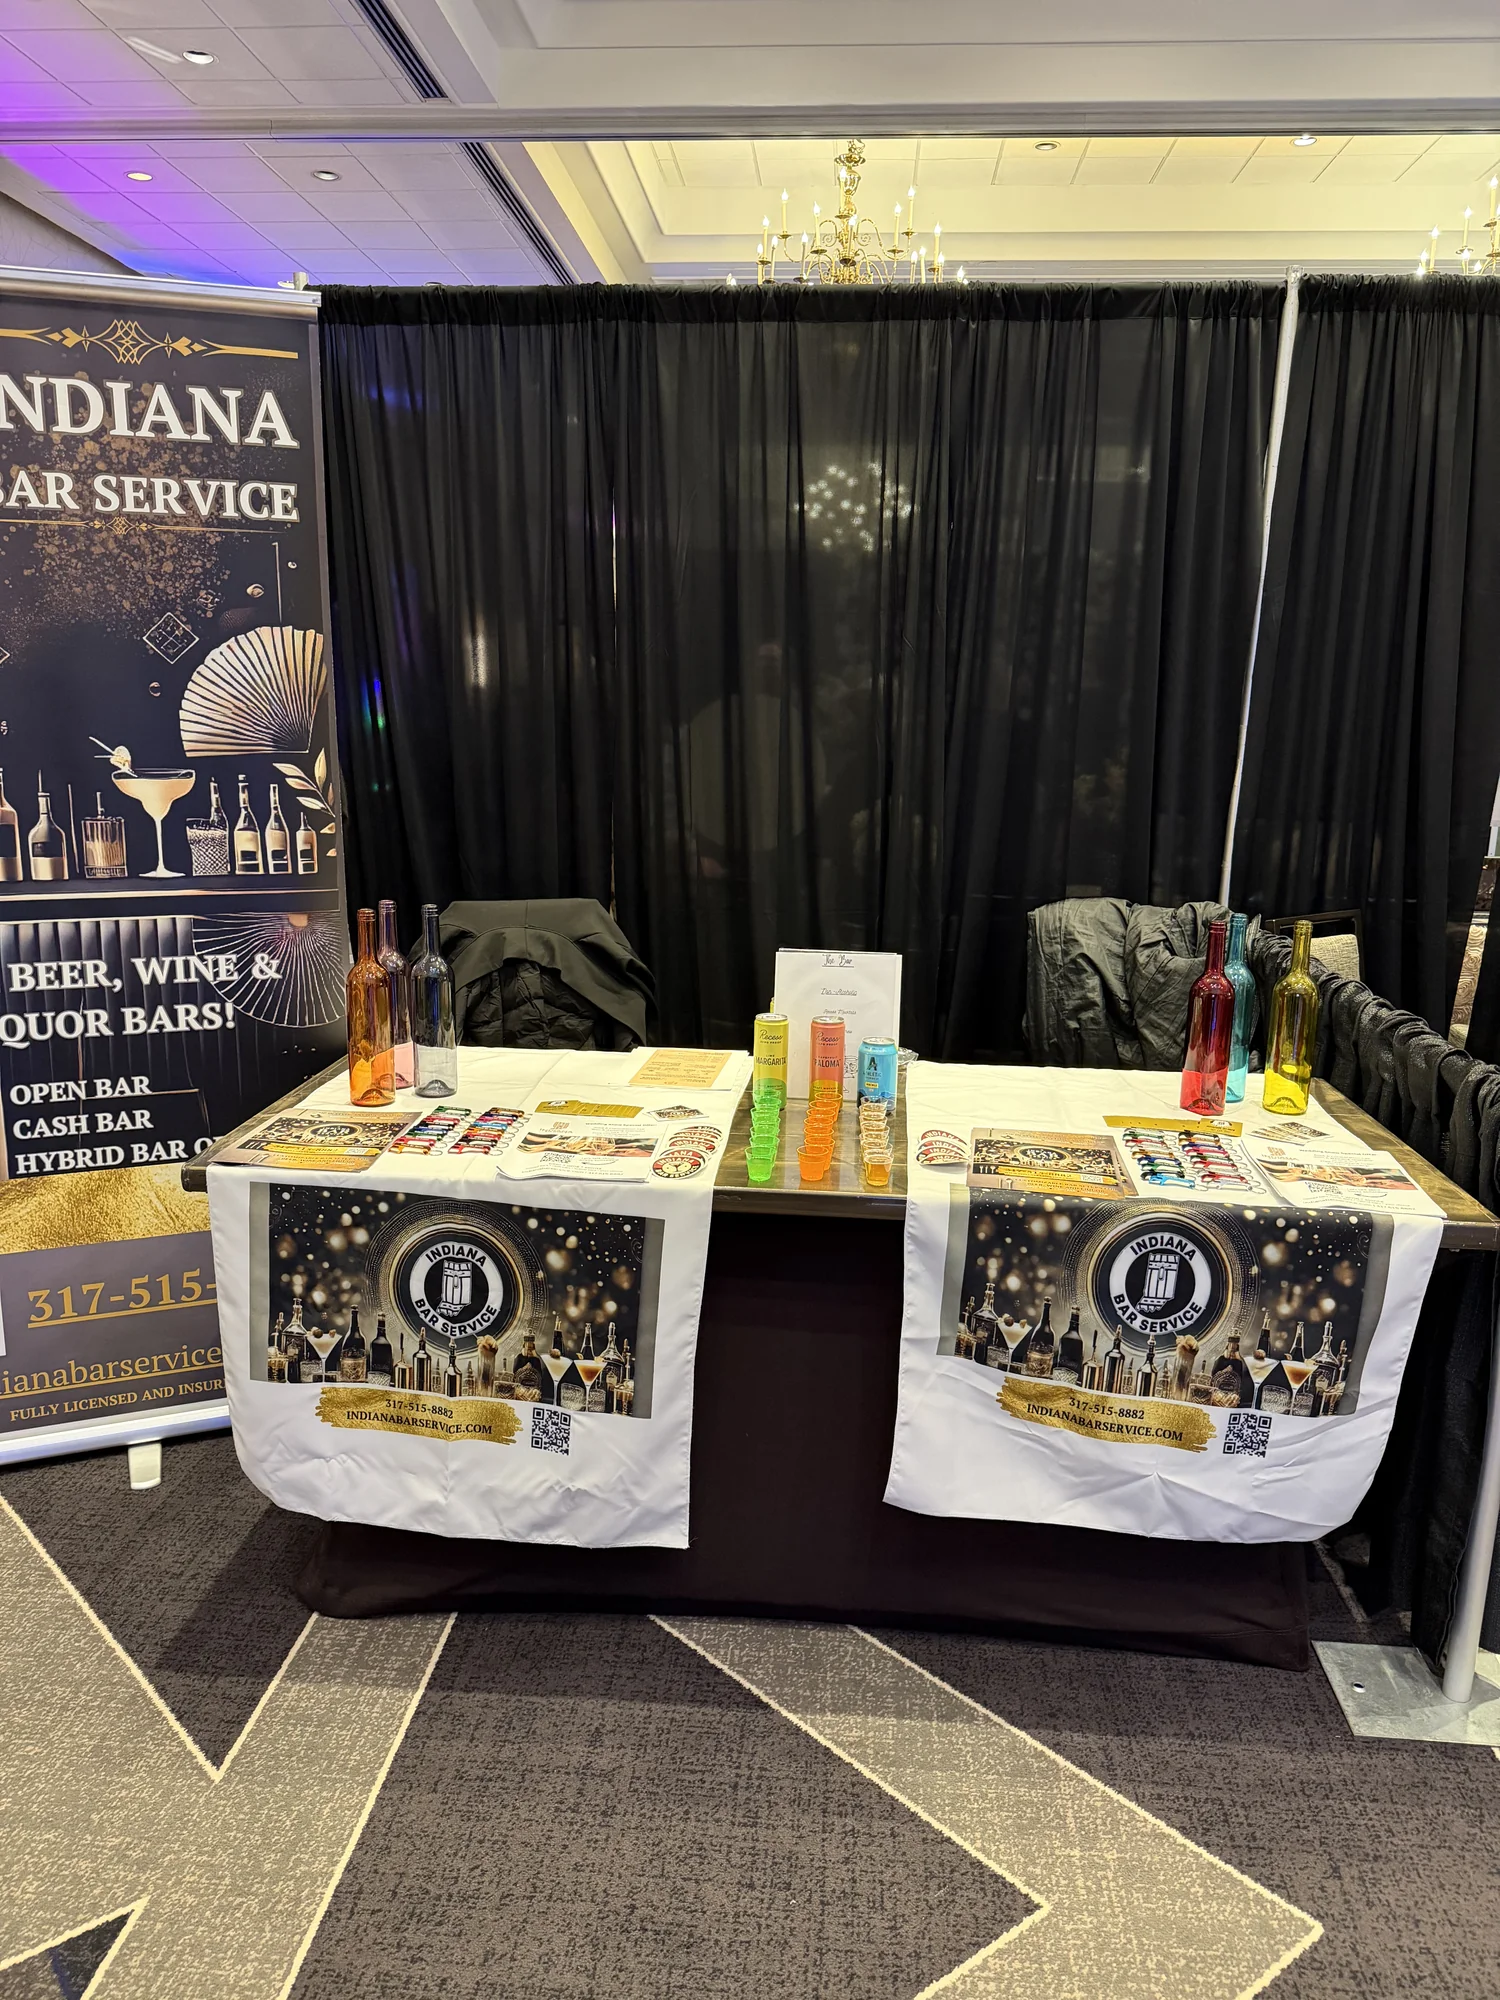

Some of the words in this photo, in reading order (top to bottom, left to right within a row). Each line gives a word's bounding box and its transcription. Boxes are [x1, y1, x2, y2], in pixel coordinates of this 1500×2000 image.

[0, 470, 80, 510] AR
[94, 474, 299, 521] SERVICE
[8, 959, 122, 993] BEER,
[131, 955, 239, 986] WINE
[251, 953, 283, 981] &
[0, 1009, 114, 1049] QUOR
[122, 1002, 235, 1035] BARS!
[756, 1056, 786, 1066] MARGARITA
[814, 1059, 840, 1068] PALOMA
[10, 1081, 87, 1105] OPEN
[94, 1076, 152, 1098] BAR
[13, 1114, 89, 1140] CASH
[96, 1110, 154, 1133] BAR
[15, 1145, 124, 1175] HYBRID
[131, 1140, 189, 1163] BAR
[194, 1135, 224, 1155] O
[657, 1157, 695, 1166] INDIANA
[425, 1244, 487, 1267] INDIANA
[1130, 1235, 1197, 1262] INDIANA
[415, 1298, 439, 1327] BAR
[441, 1305, 498, 1337] SERVICE
[1113, 1293, 1138, 1325] BAR
[1139, 1302, 1203, 1333] SERVICE
[0, 1344, 222, 1394] ianabarservice
[10, 1403, 59, 1422] FULLY
[63, 1391, 138, 1413] LICENSED
[142, 1386, 175, 1401] AND
[385, 1398, 454, 1419] 317-515-8882
[1069, 1397, 1146, 1420] 317-515-8882
[346, 1410, 493, 1435] INDIANABARSERVICE.COM
[1026, 1403, 1184, 1442] INDIANABARSERVICE.COM
